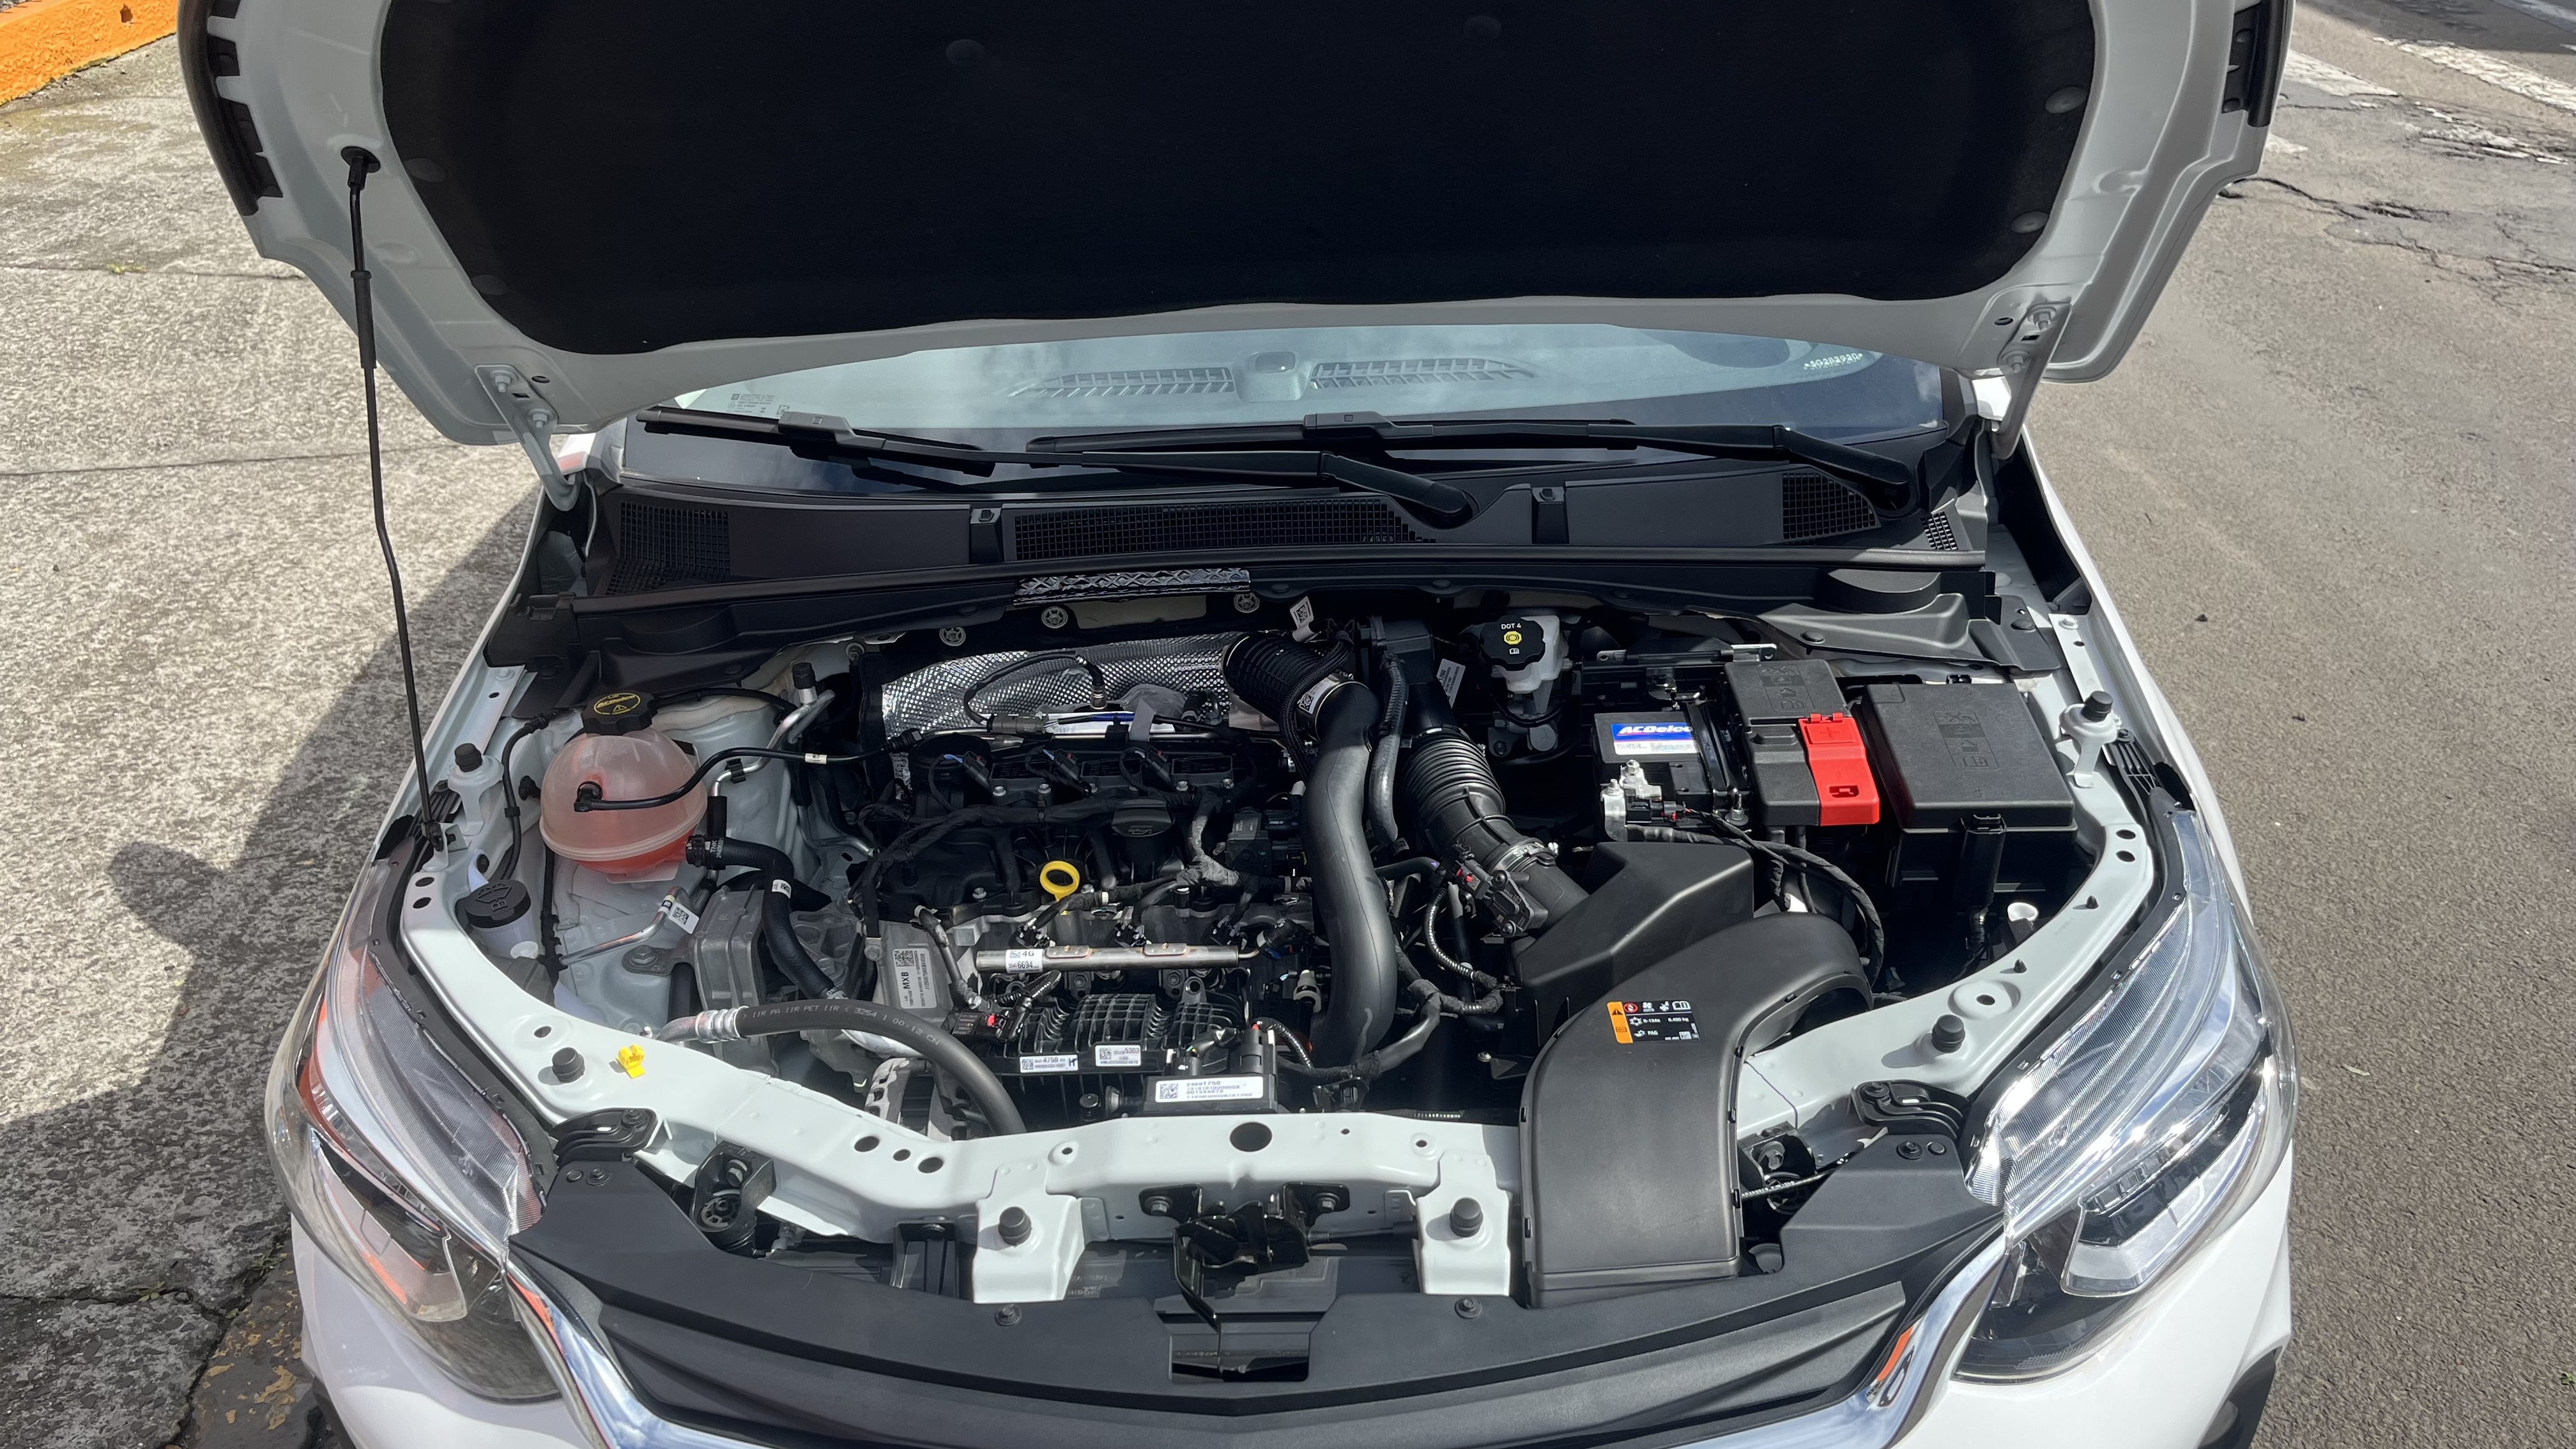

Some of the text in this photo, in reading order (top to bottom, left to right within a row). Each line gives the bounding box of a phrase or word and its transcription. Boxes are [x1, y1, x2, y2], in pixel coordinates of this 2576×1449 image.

[901, 972, 911, 990] MXB
[854, 1007, 878, 1018] 3254
[926, 1034, 940, 1046] CN
